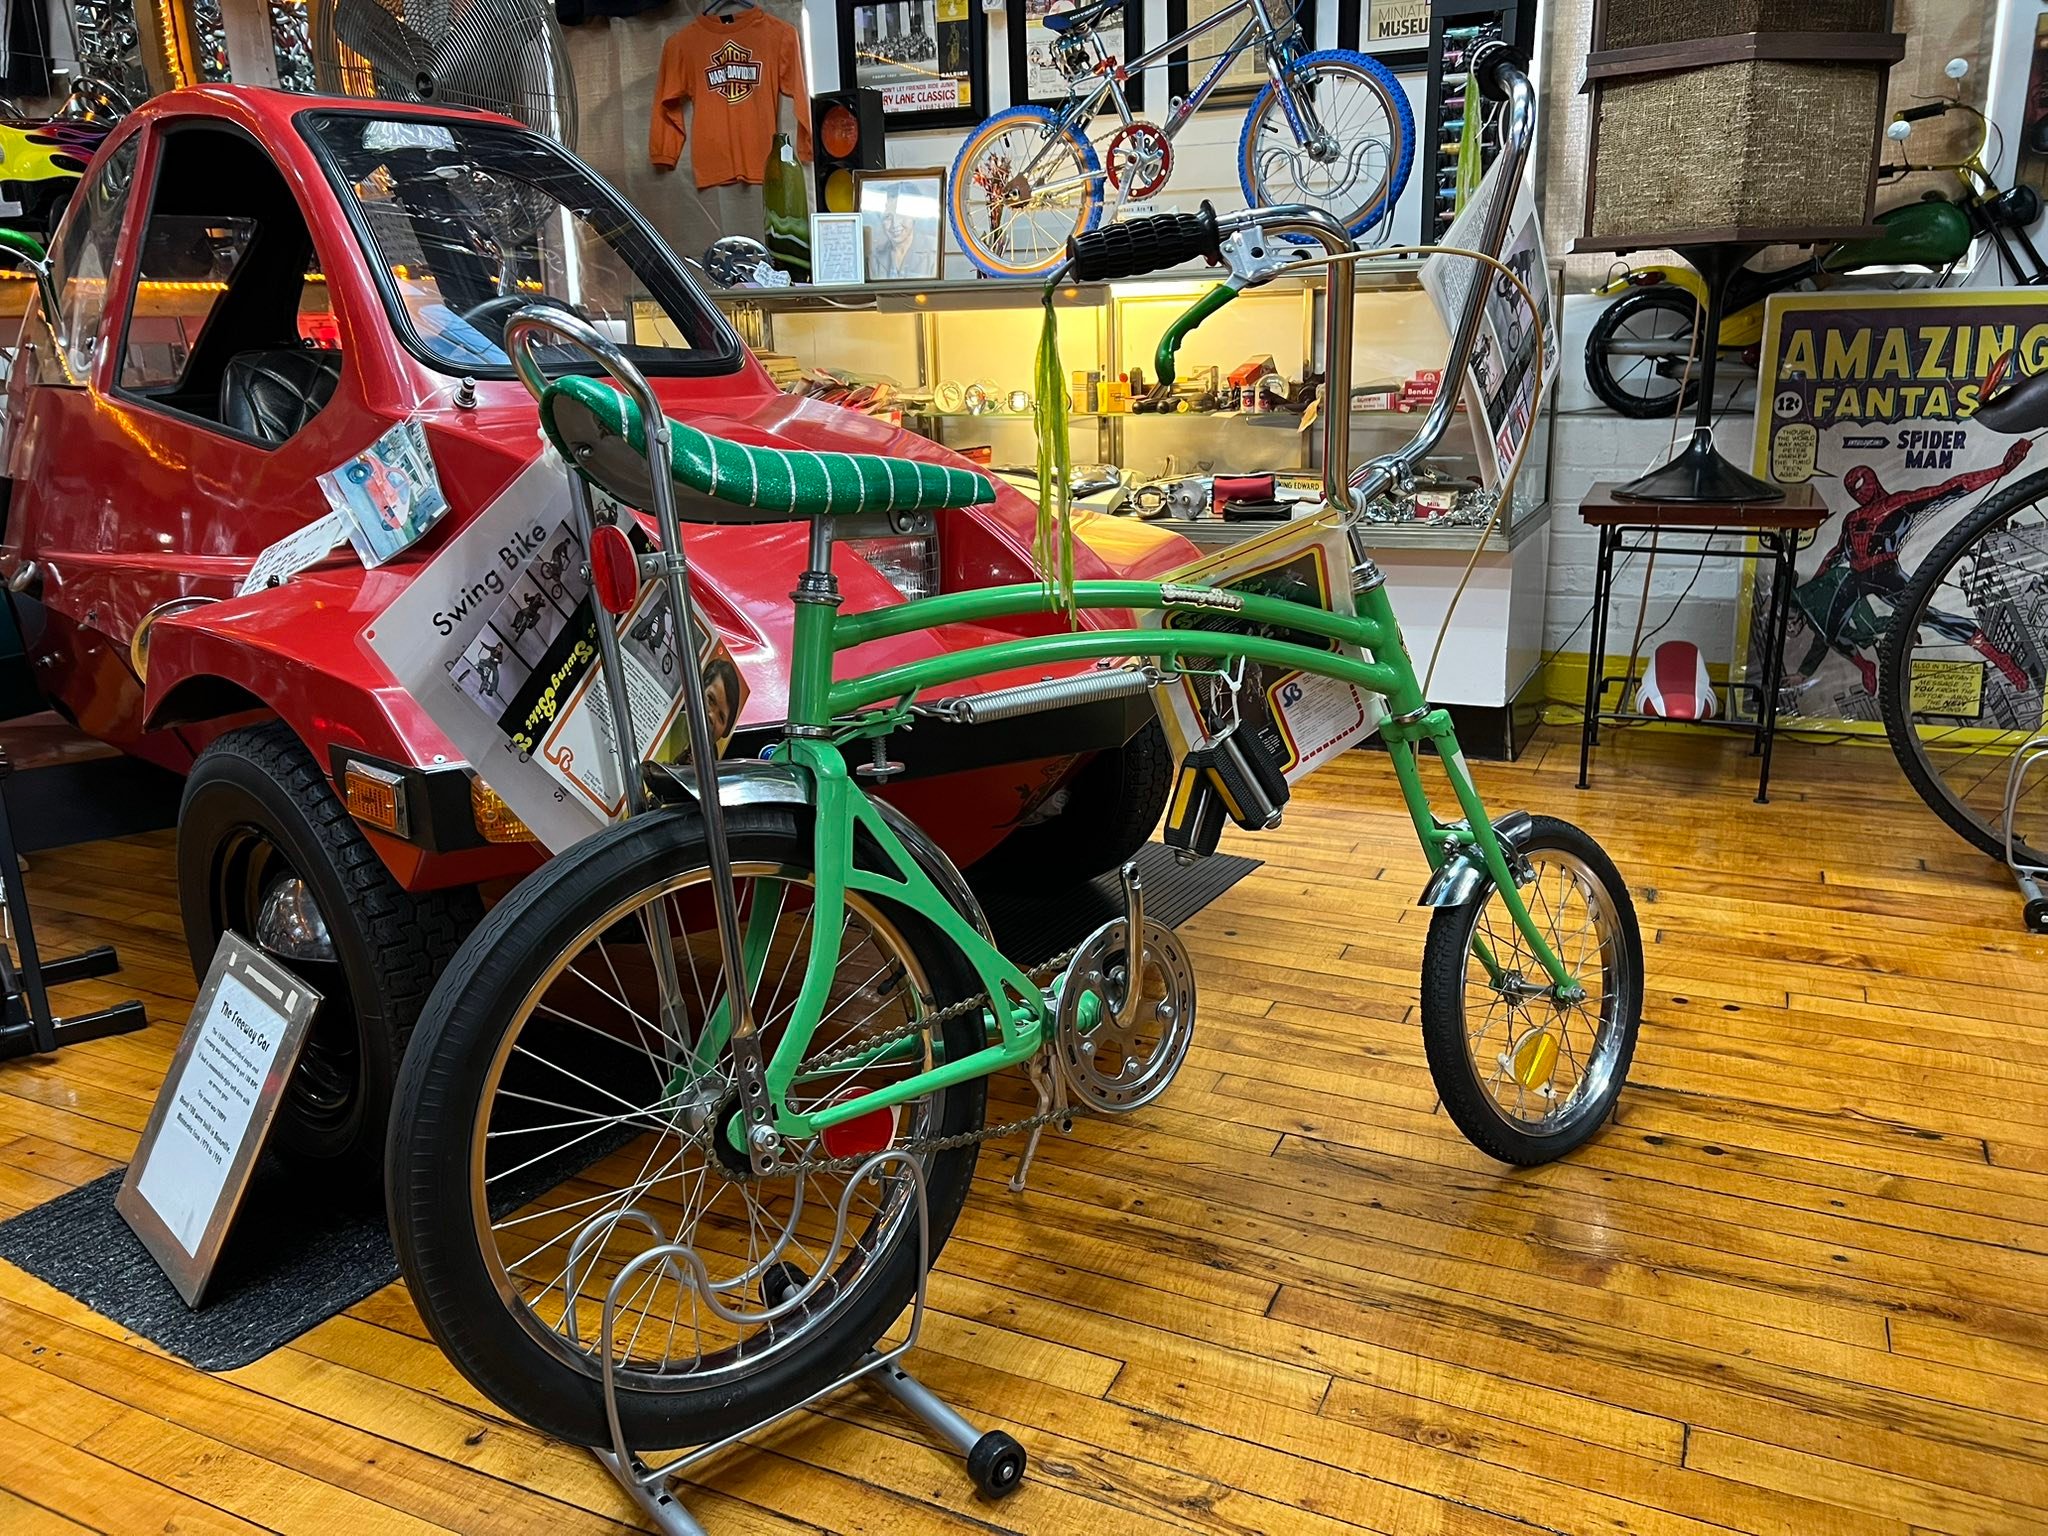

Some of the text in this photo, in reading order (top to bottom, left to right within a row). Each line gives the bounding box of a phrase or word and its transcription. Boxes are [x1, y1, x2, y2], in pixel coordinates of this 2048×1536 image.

[1379, 17, 1428, 37] MUSEU
[1189, 55, 1227, 99] mongoose
[895, 92, 916, 104] LANE
[917, 89, 956, 102] CLASSICS
[1779, 323, 2048, 381] AMAZING
[1407, 387, 1433, 395] Bendix
[1814, 384, 1996, 419] FANTAS
[1896, 430, 1967, 450] SPIDER
[1904, 450, 1953, 469] MAN
[1293, 481, 1320, 490] EDWARD
[432, 525, 547, 636] Swing Bike
[221, 1000, 271, 1052] The Freeway Car
